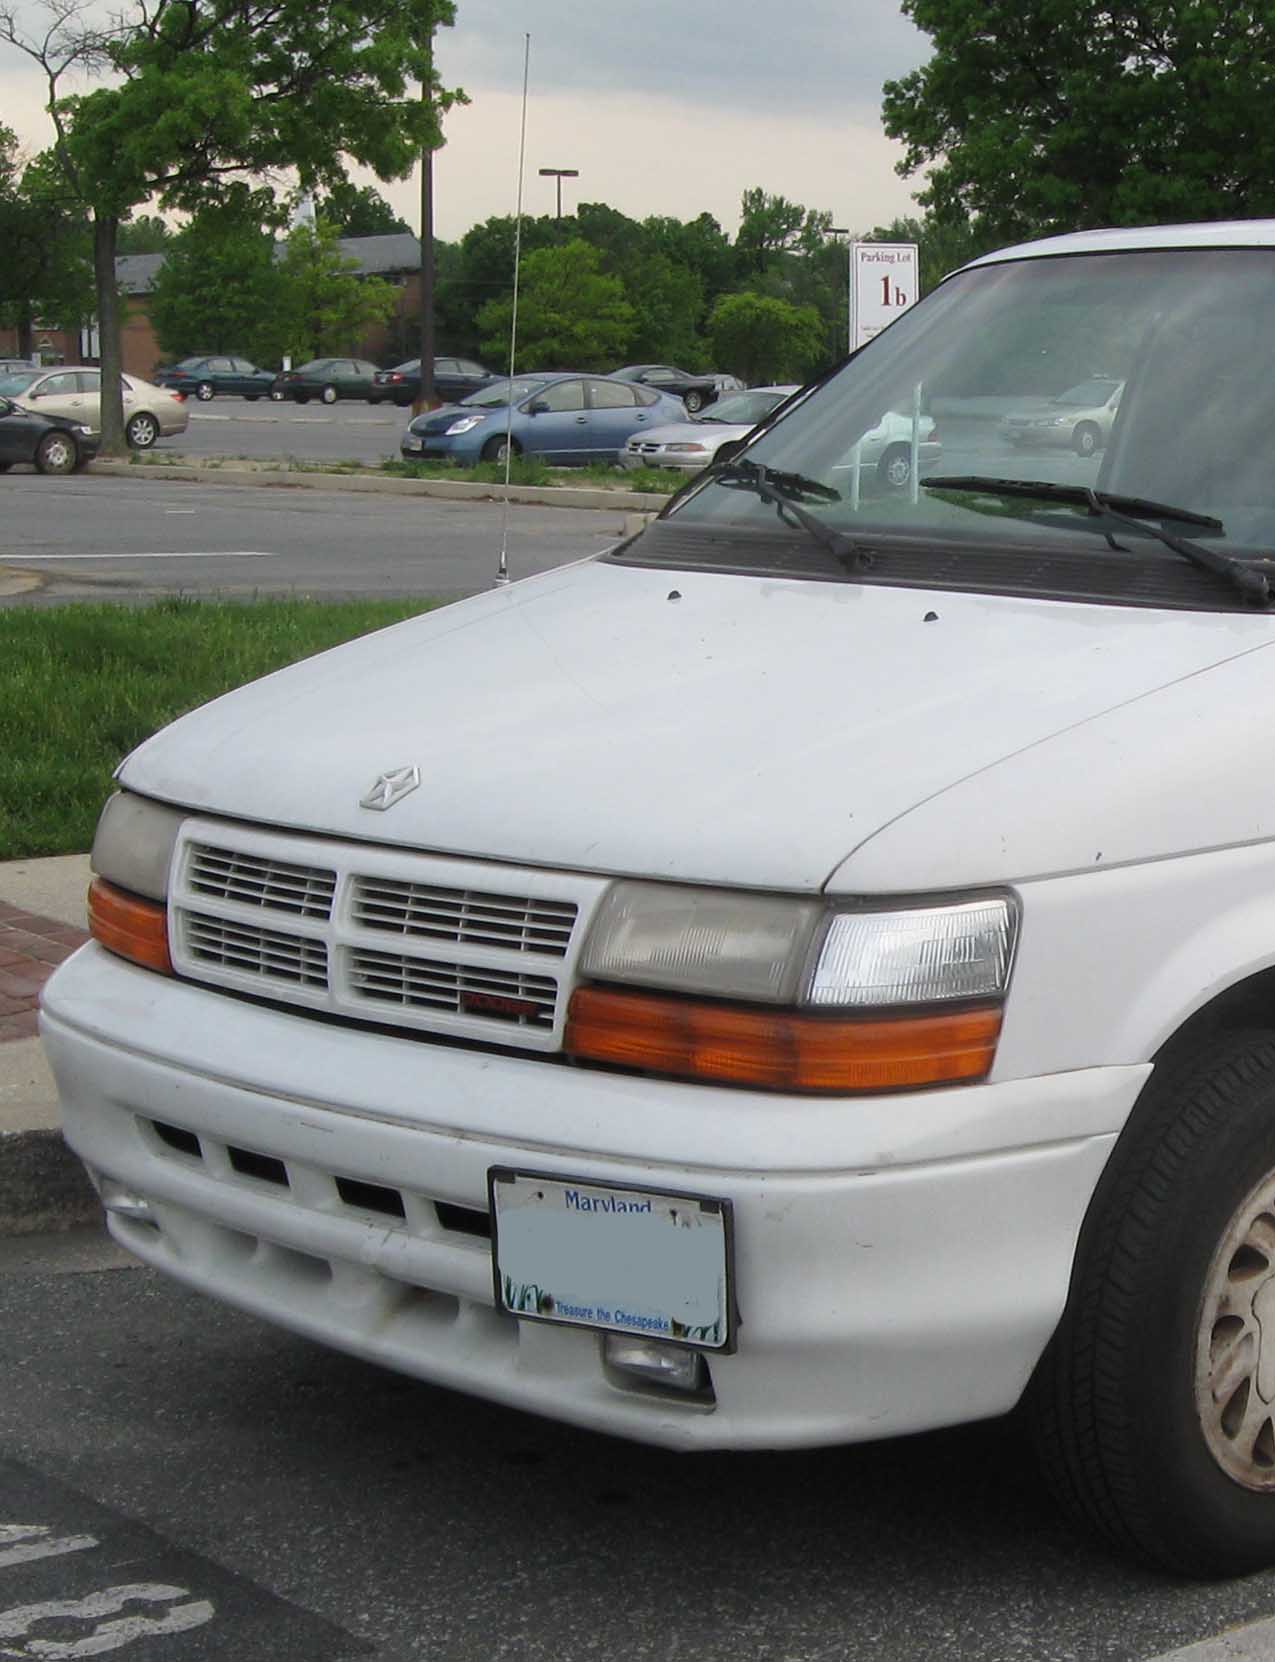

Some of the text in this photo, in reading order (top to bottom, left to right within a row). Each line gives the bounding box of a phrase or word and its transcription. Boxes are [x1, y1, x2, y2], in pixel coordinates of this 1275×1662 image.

[861, 252, 911, 264] Parking Lot
[556, 1301, 669, 1331] Treasure the Chesapeake
